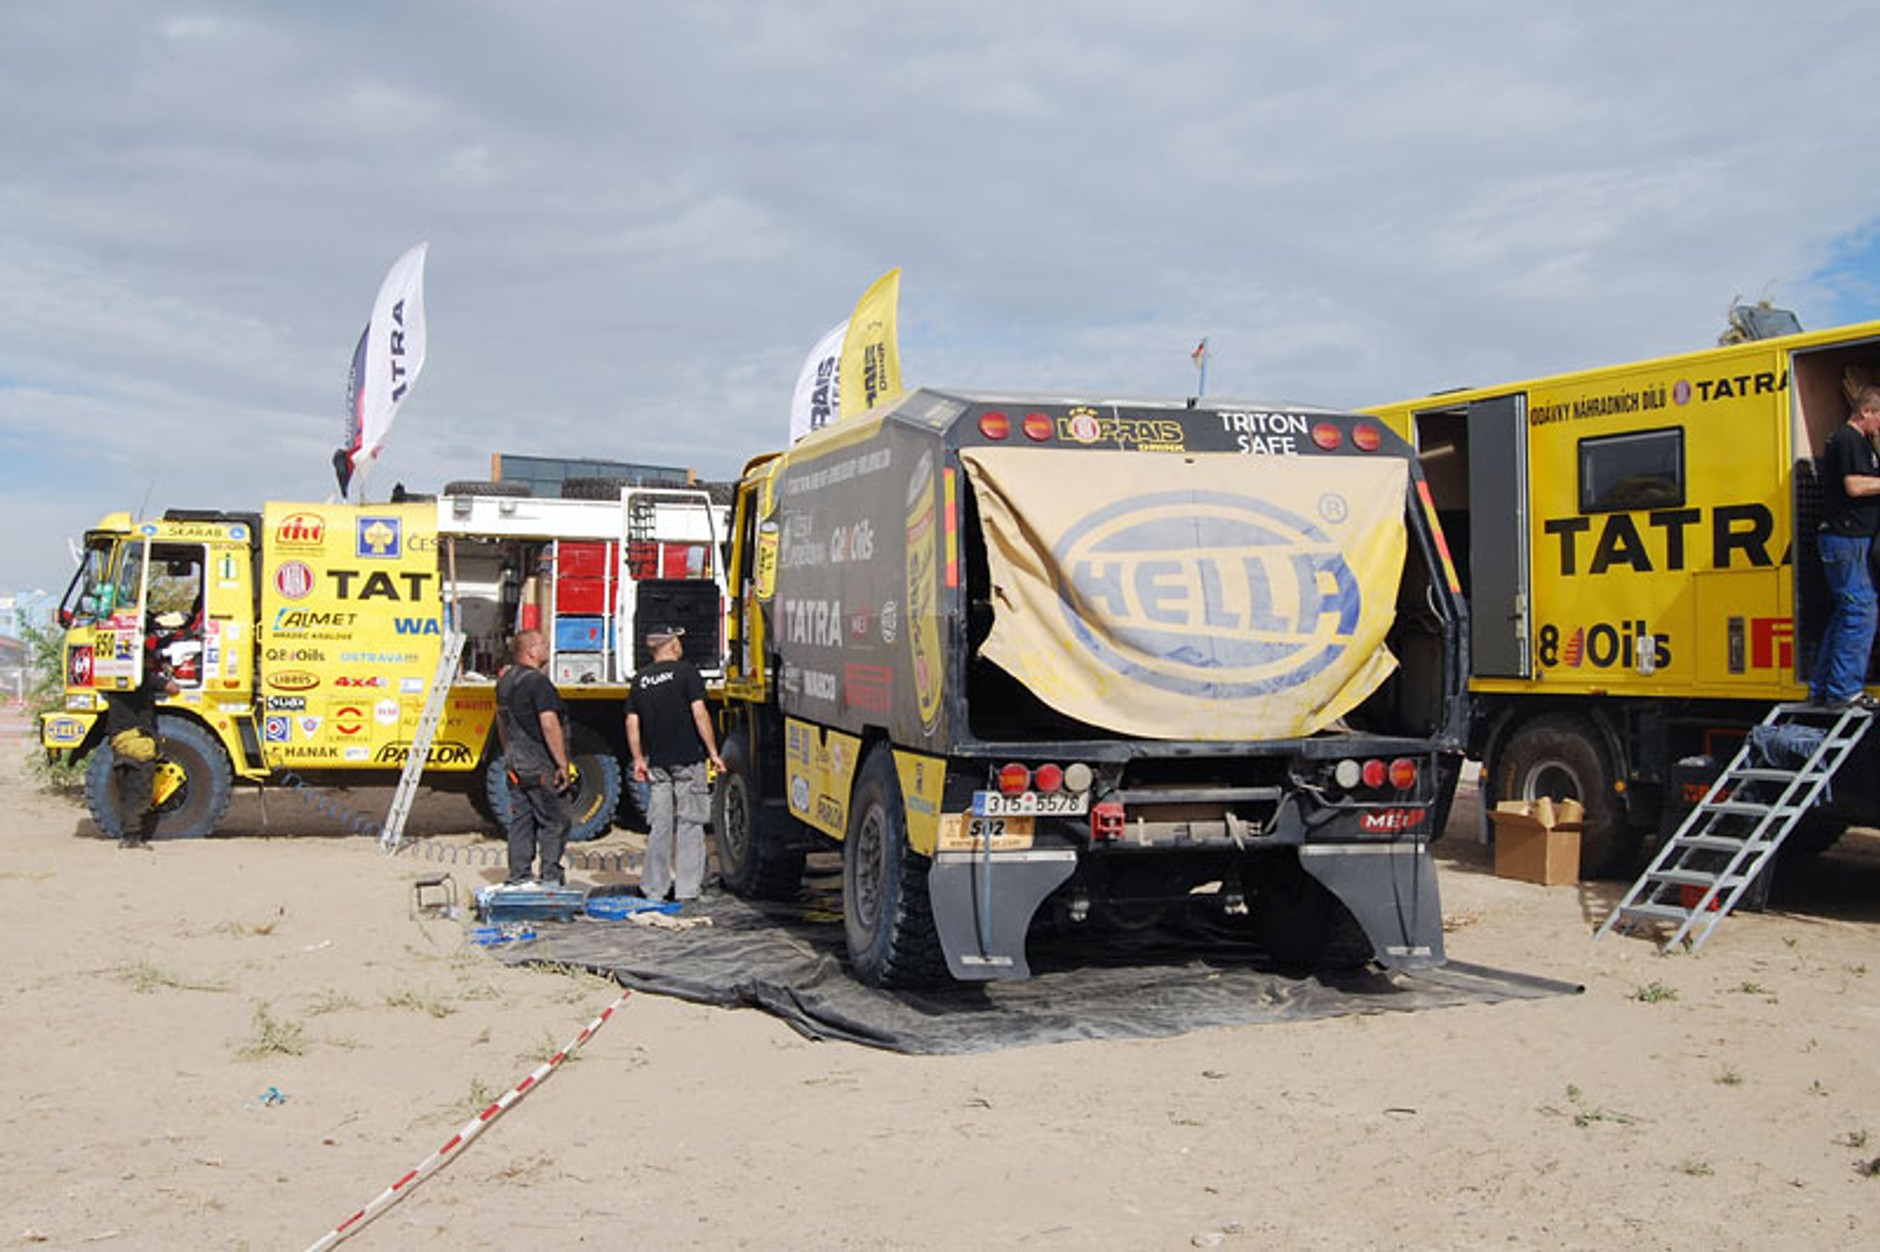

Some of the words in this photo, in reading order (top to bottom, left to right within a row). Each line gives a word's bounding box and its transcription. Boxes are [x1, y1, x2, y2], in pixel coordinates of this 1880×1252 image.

[1218, 412, 1308, 435] TRITON
[1237, 435, 1298, 454] SAFE
[1544, 503, 1793, 577] TATR
[326, 570, 443, 602] TAT
[1072, 552, 1361, 635] HELLA
[785, 599, 844, 648] TATRA
